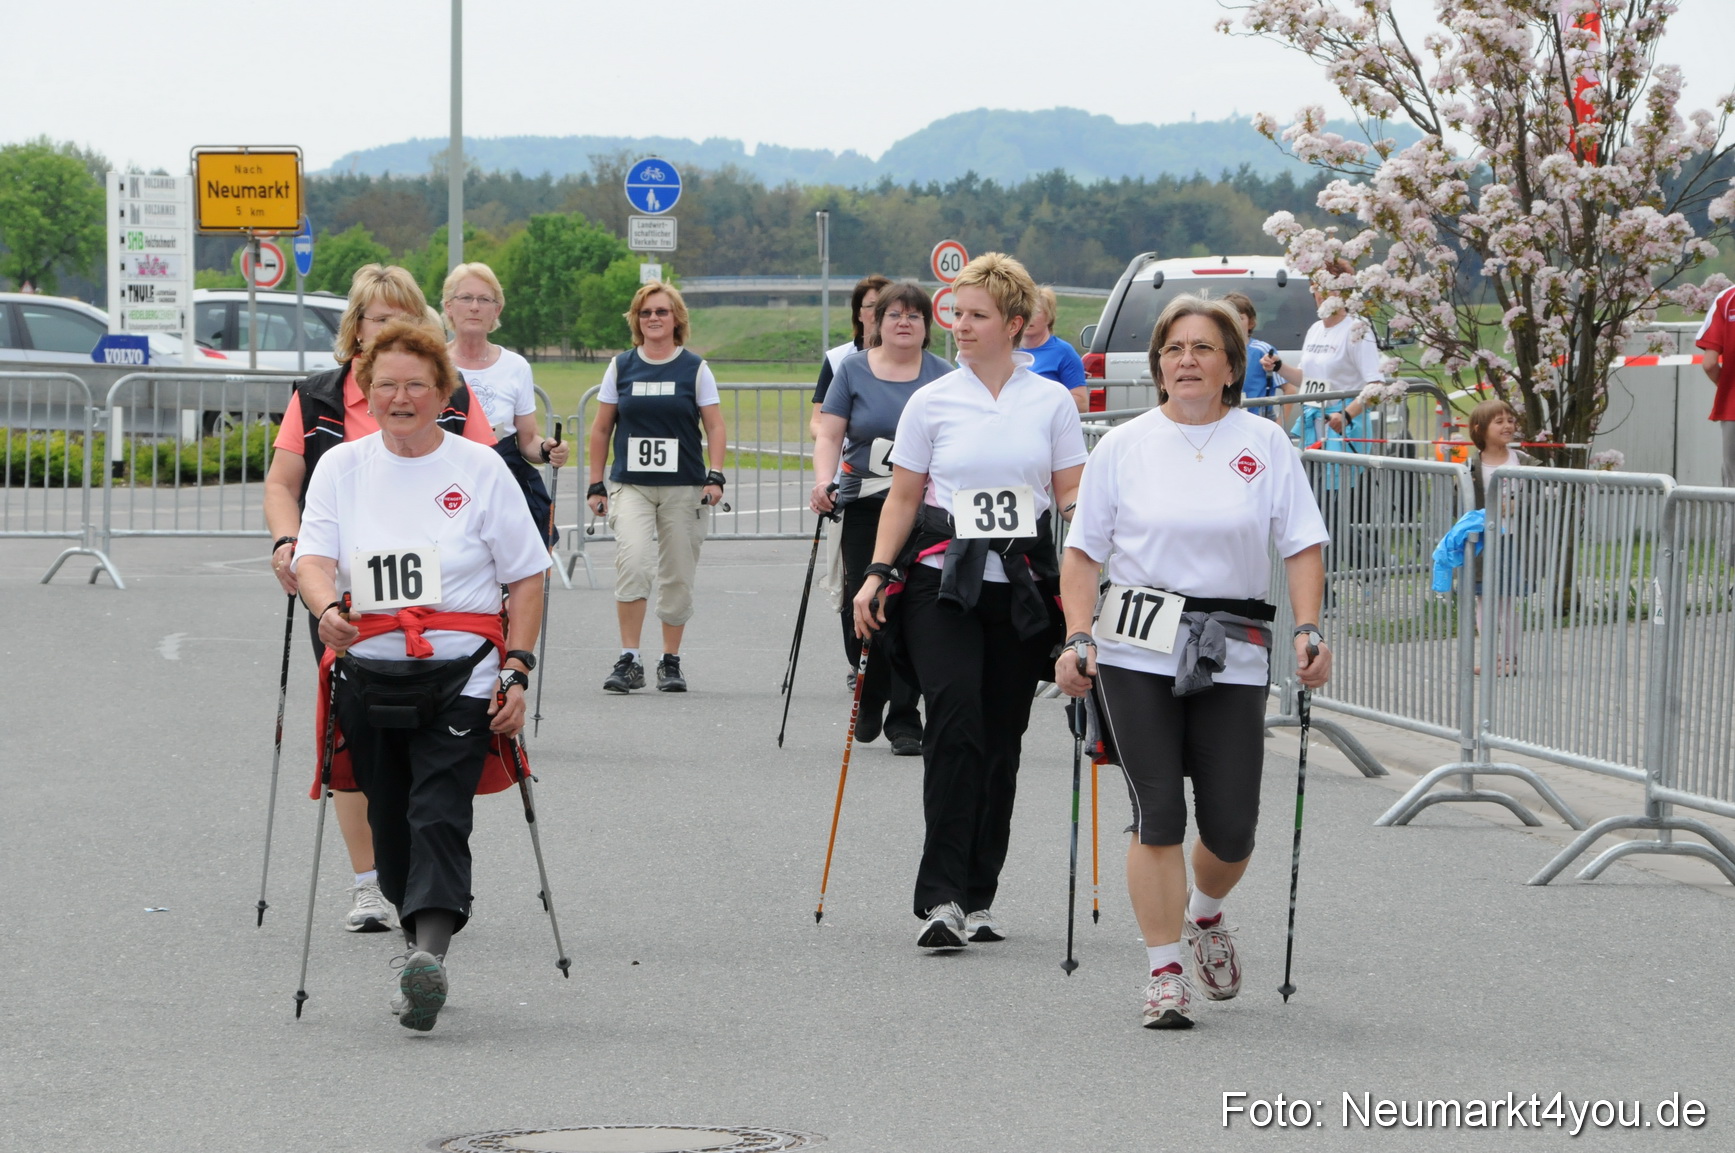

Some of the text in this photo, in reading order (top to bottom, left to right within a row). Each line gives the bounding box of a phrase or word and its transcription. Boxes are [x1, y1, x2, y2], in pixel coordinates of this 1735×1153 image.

[234, 165, 263, 174] Nach
[207, 180, 290, 199] Neumarkt
[235, 206, 265, 216] 5 km
[634, 230, 671, 238] schaftlicher
[637, 221, 668, 229] Landwirt-
[127, 231, 144, 250] SHB
[634, 238, 672, 246] Verkehr frei
[940, 253, 960, 272] 60
[127, 284, 154, 303] THULE
[103, 348, 144, 364] VOLVO
[638, 439, 667, 467] 95
[881, 443, 895, 472] 4
[1243, 465, 1252, 473] SV
[448, 501, 458, 509] SV
[973, 490, 1019, 532] 33
[367, 552, 423, 602] 116
[1115, 589, 1165, 641] 117
